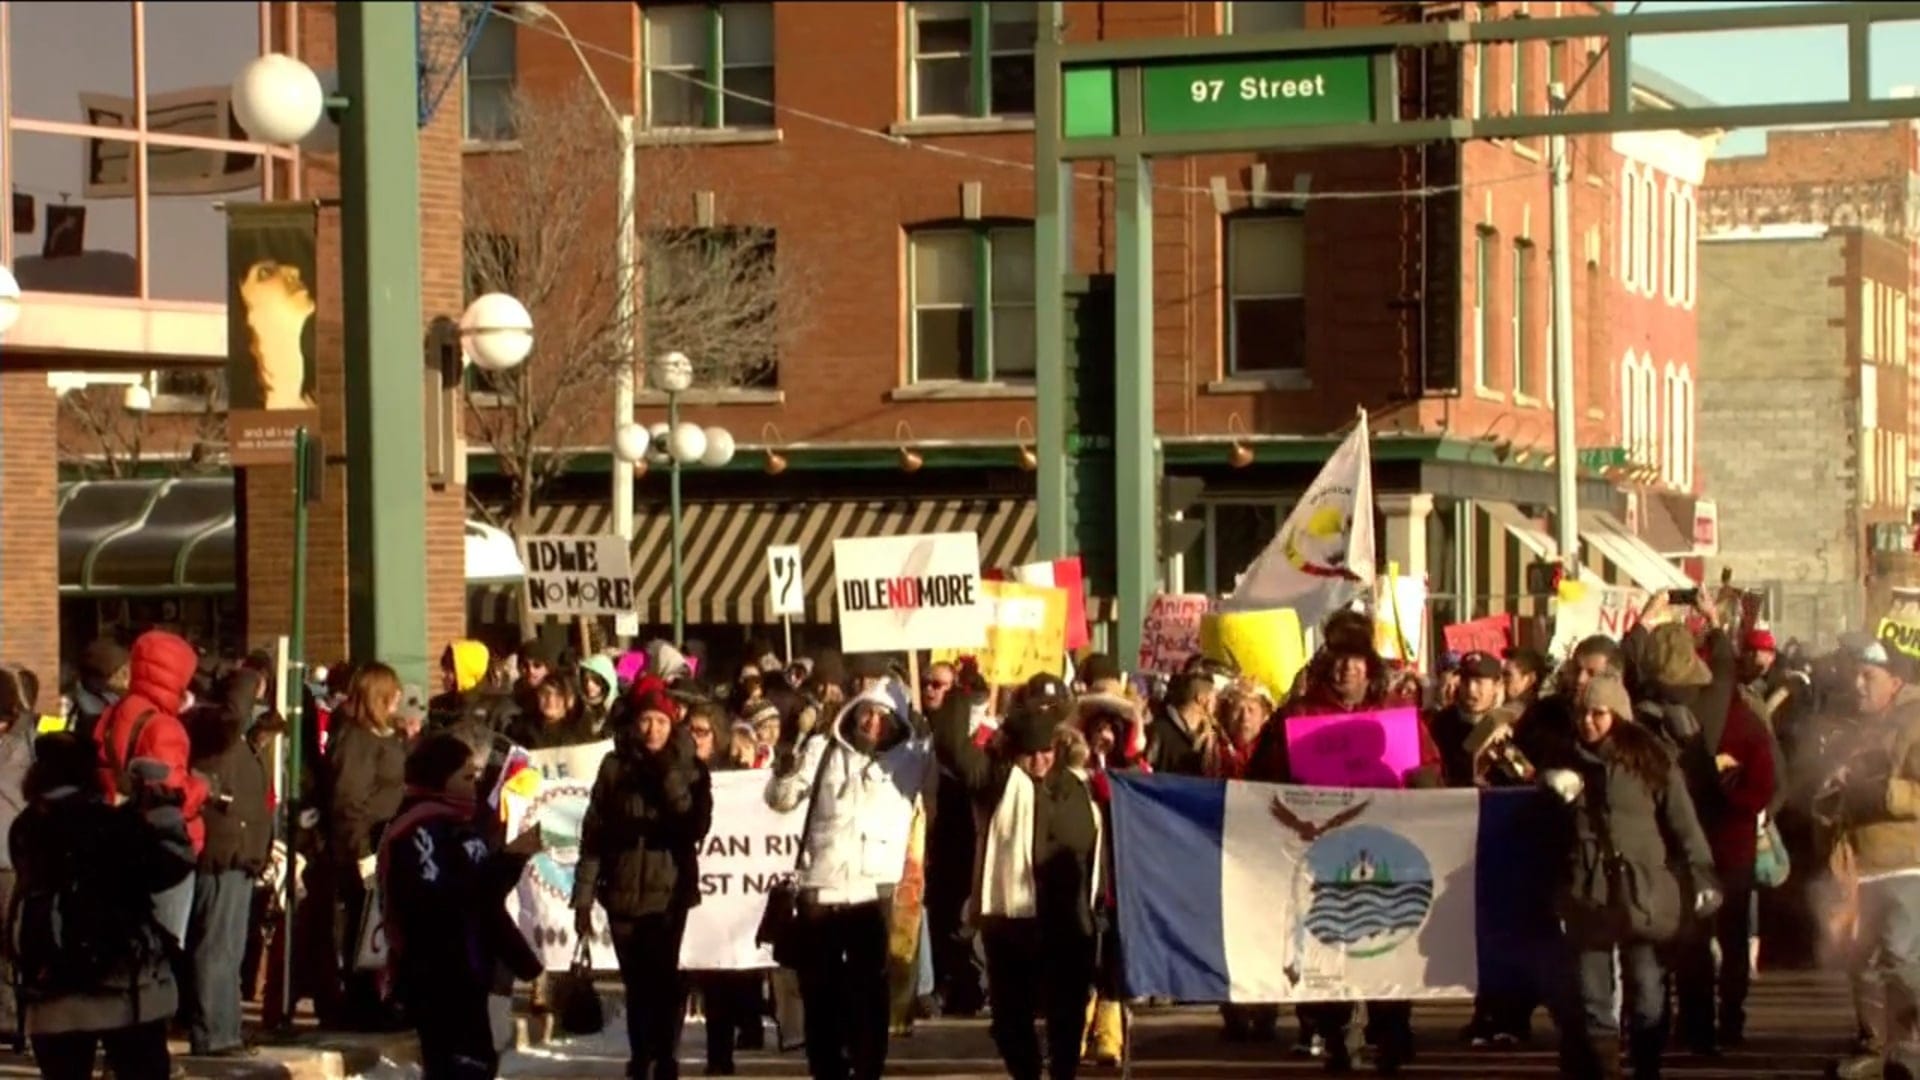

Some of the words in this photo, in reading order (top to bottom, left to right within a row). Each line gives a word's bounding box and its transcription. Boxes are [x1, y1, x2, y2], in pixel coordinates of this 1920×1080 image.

[1190, 80, 1224, 102] 97
[1239, 74, 1325, 100] Street
[527, 540, 599, 572] IDLE
[843, 574, 976, 611] IDLENOMORE
